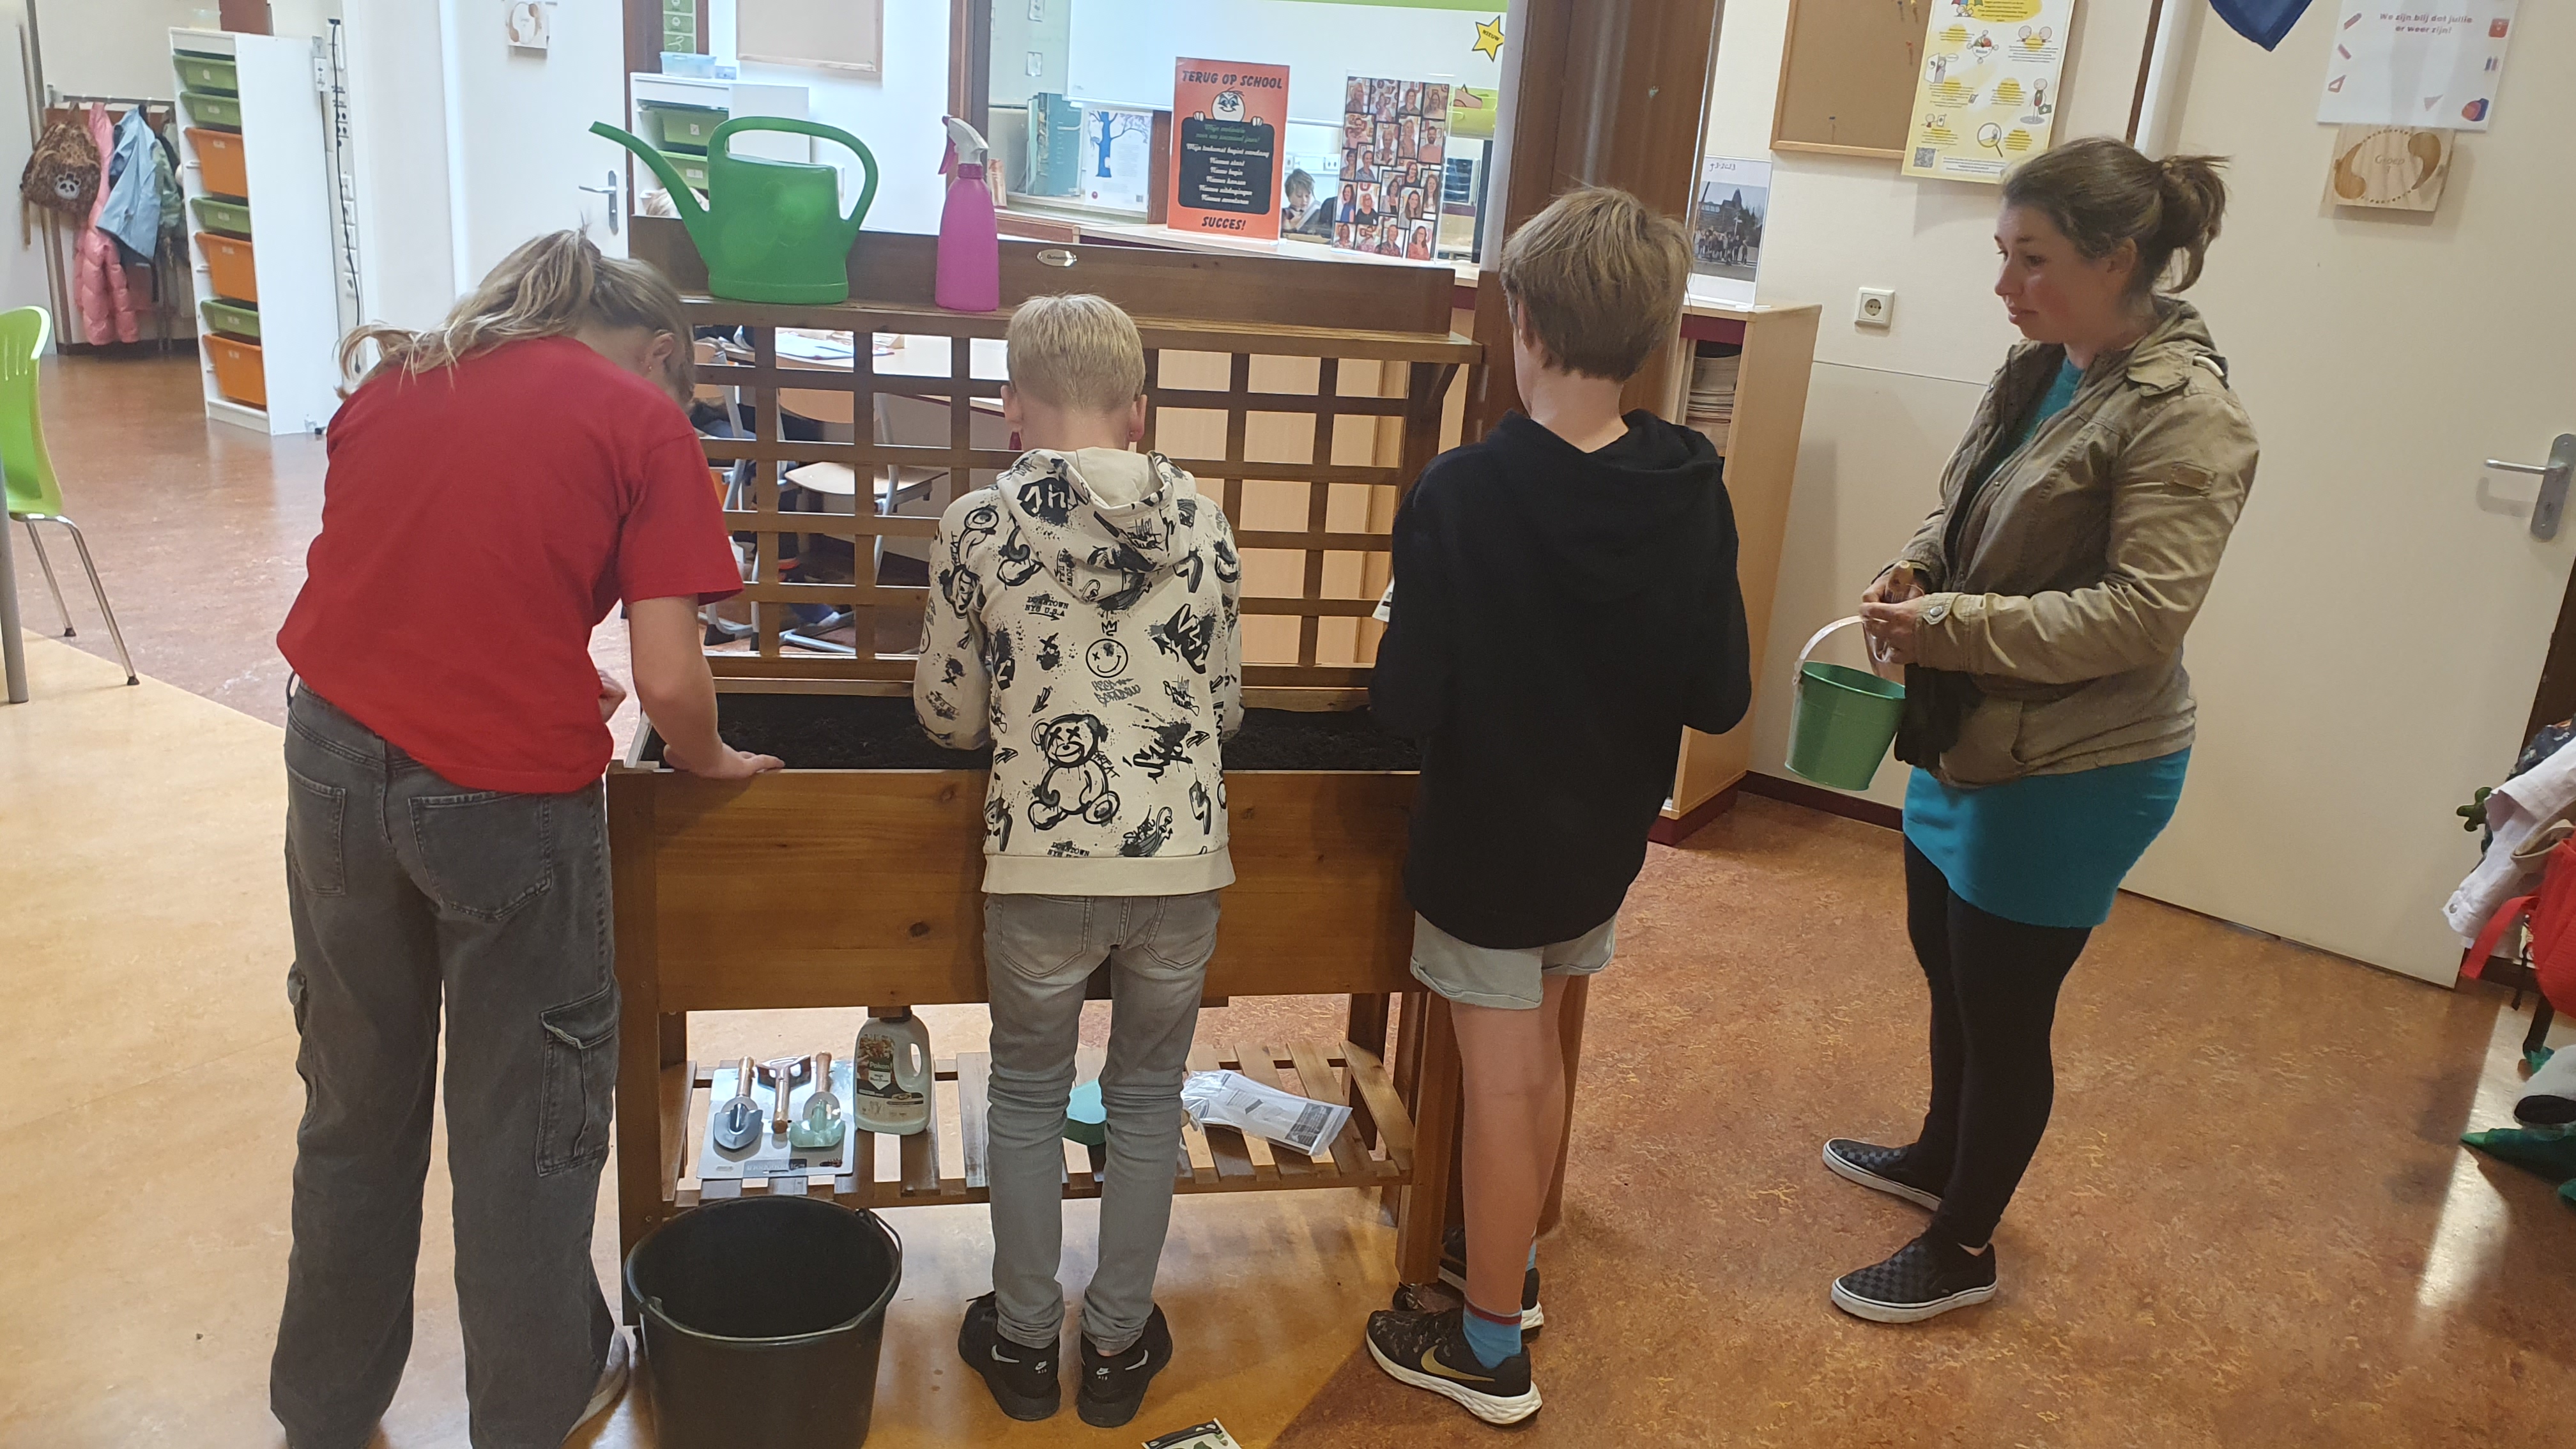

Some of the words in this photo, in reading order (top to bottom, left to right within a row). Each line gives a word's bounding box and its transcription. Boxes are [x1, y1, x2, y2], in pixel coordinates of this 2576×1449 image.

[2395, 13, 2412, 22] zijn
[2414, 14, 2430, 23] blij
[2448, 15, 2473, 24] jullie
[1482, 29, 1500, 41] NIEUW
[2432, 26, 2452, 35] zijn!
[1182, 70, 1218, 84] TERUG
[1222, 73, 1238, 85] OP
[1239, 75, 1282, 89] SCHOOL
[2375, 154, 2405, 165] Groep
[1201, 216, 1246, 231] SUCCES!
[1027, 596, 1069, 610] DONTOWN
[1050, 841, 1090, 857] DONTOWN
